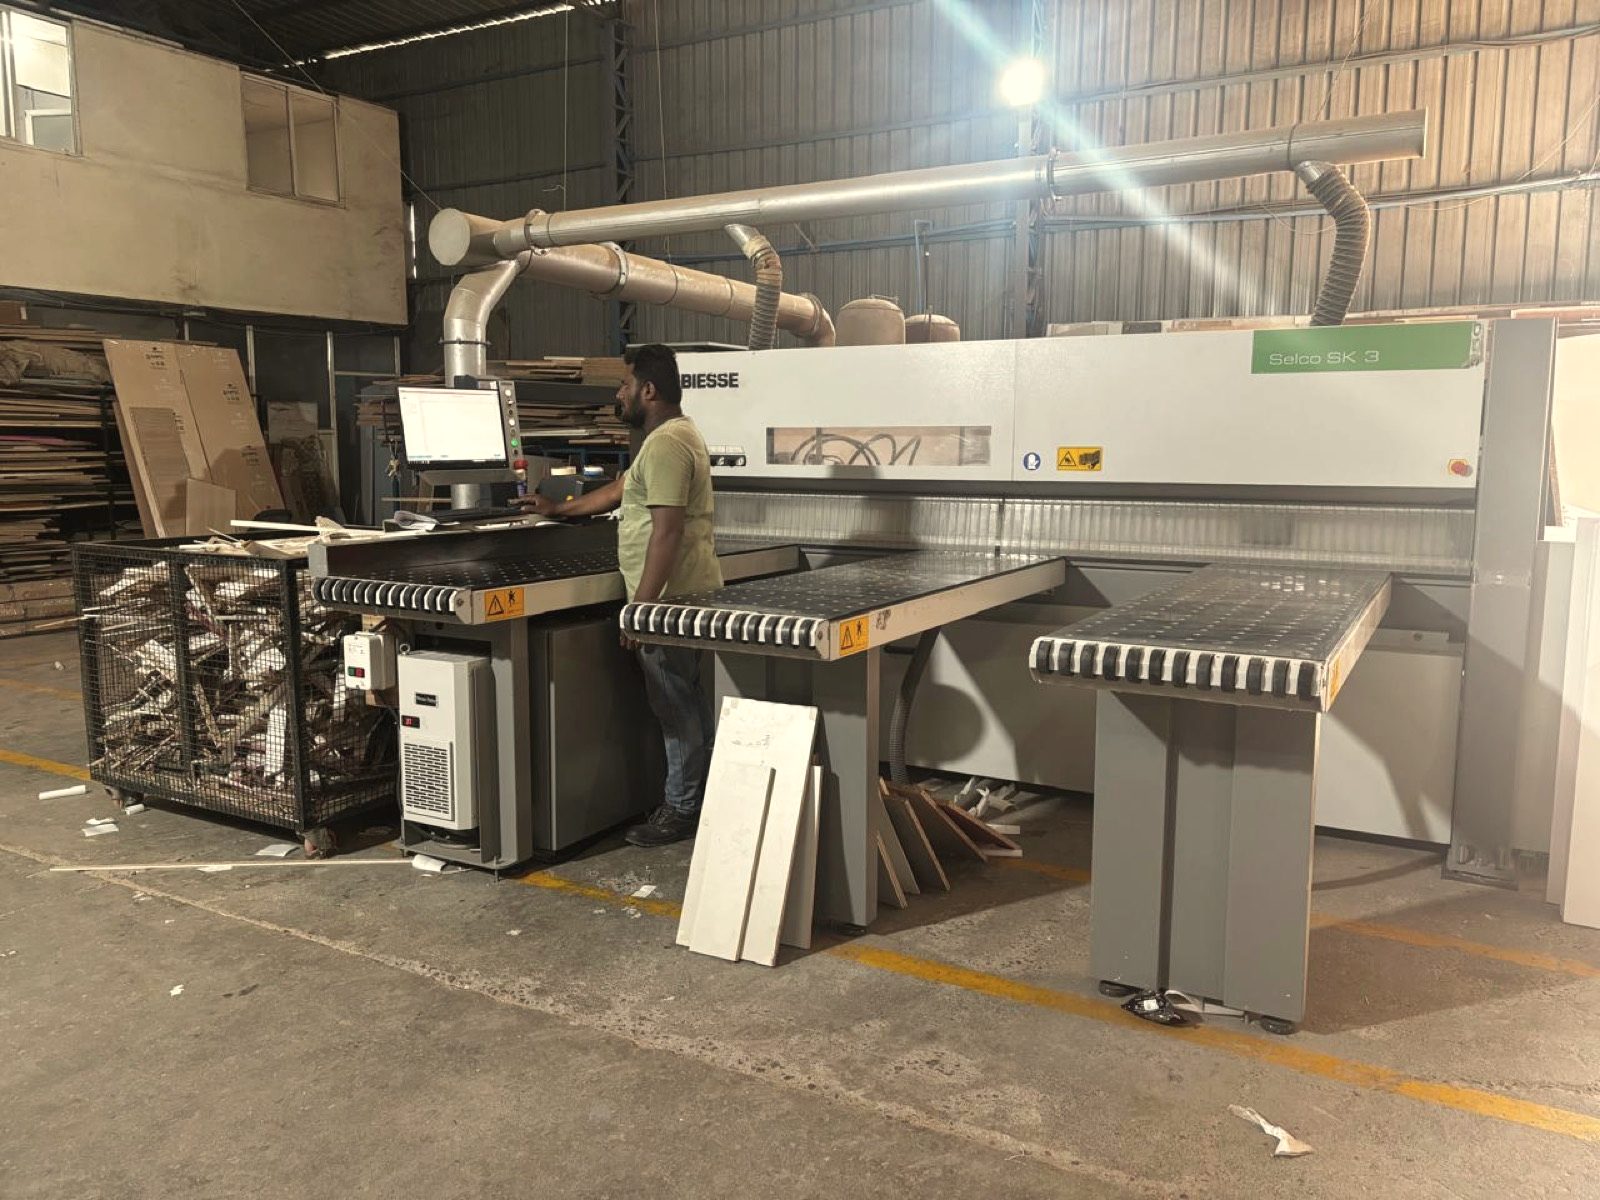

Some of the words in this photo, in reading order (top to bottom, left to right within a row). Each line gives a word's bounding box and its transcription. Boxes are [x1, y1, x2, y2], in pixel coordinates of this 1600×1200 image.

[1269, 352, 1321, 366] Selco
[1327, 351, 1356, 365] SK
[1364, 350, 1380, 363] 3
[681, 372, 739, 389] BIESSE
